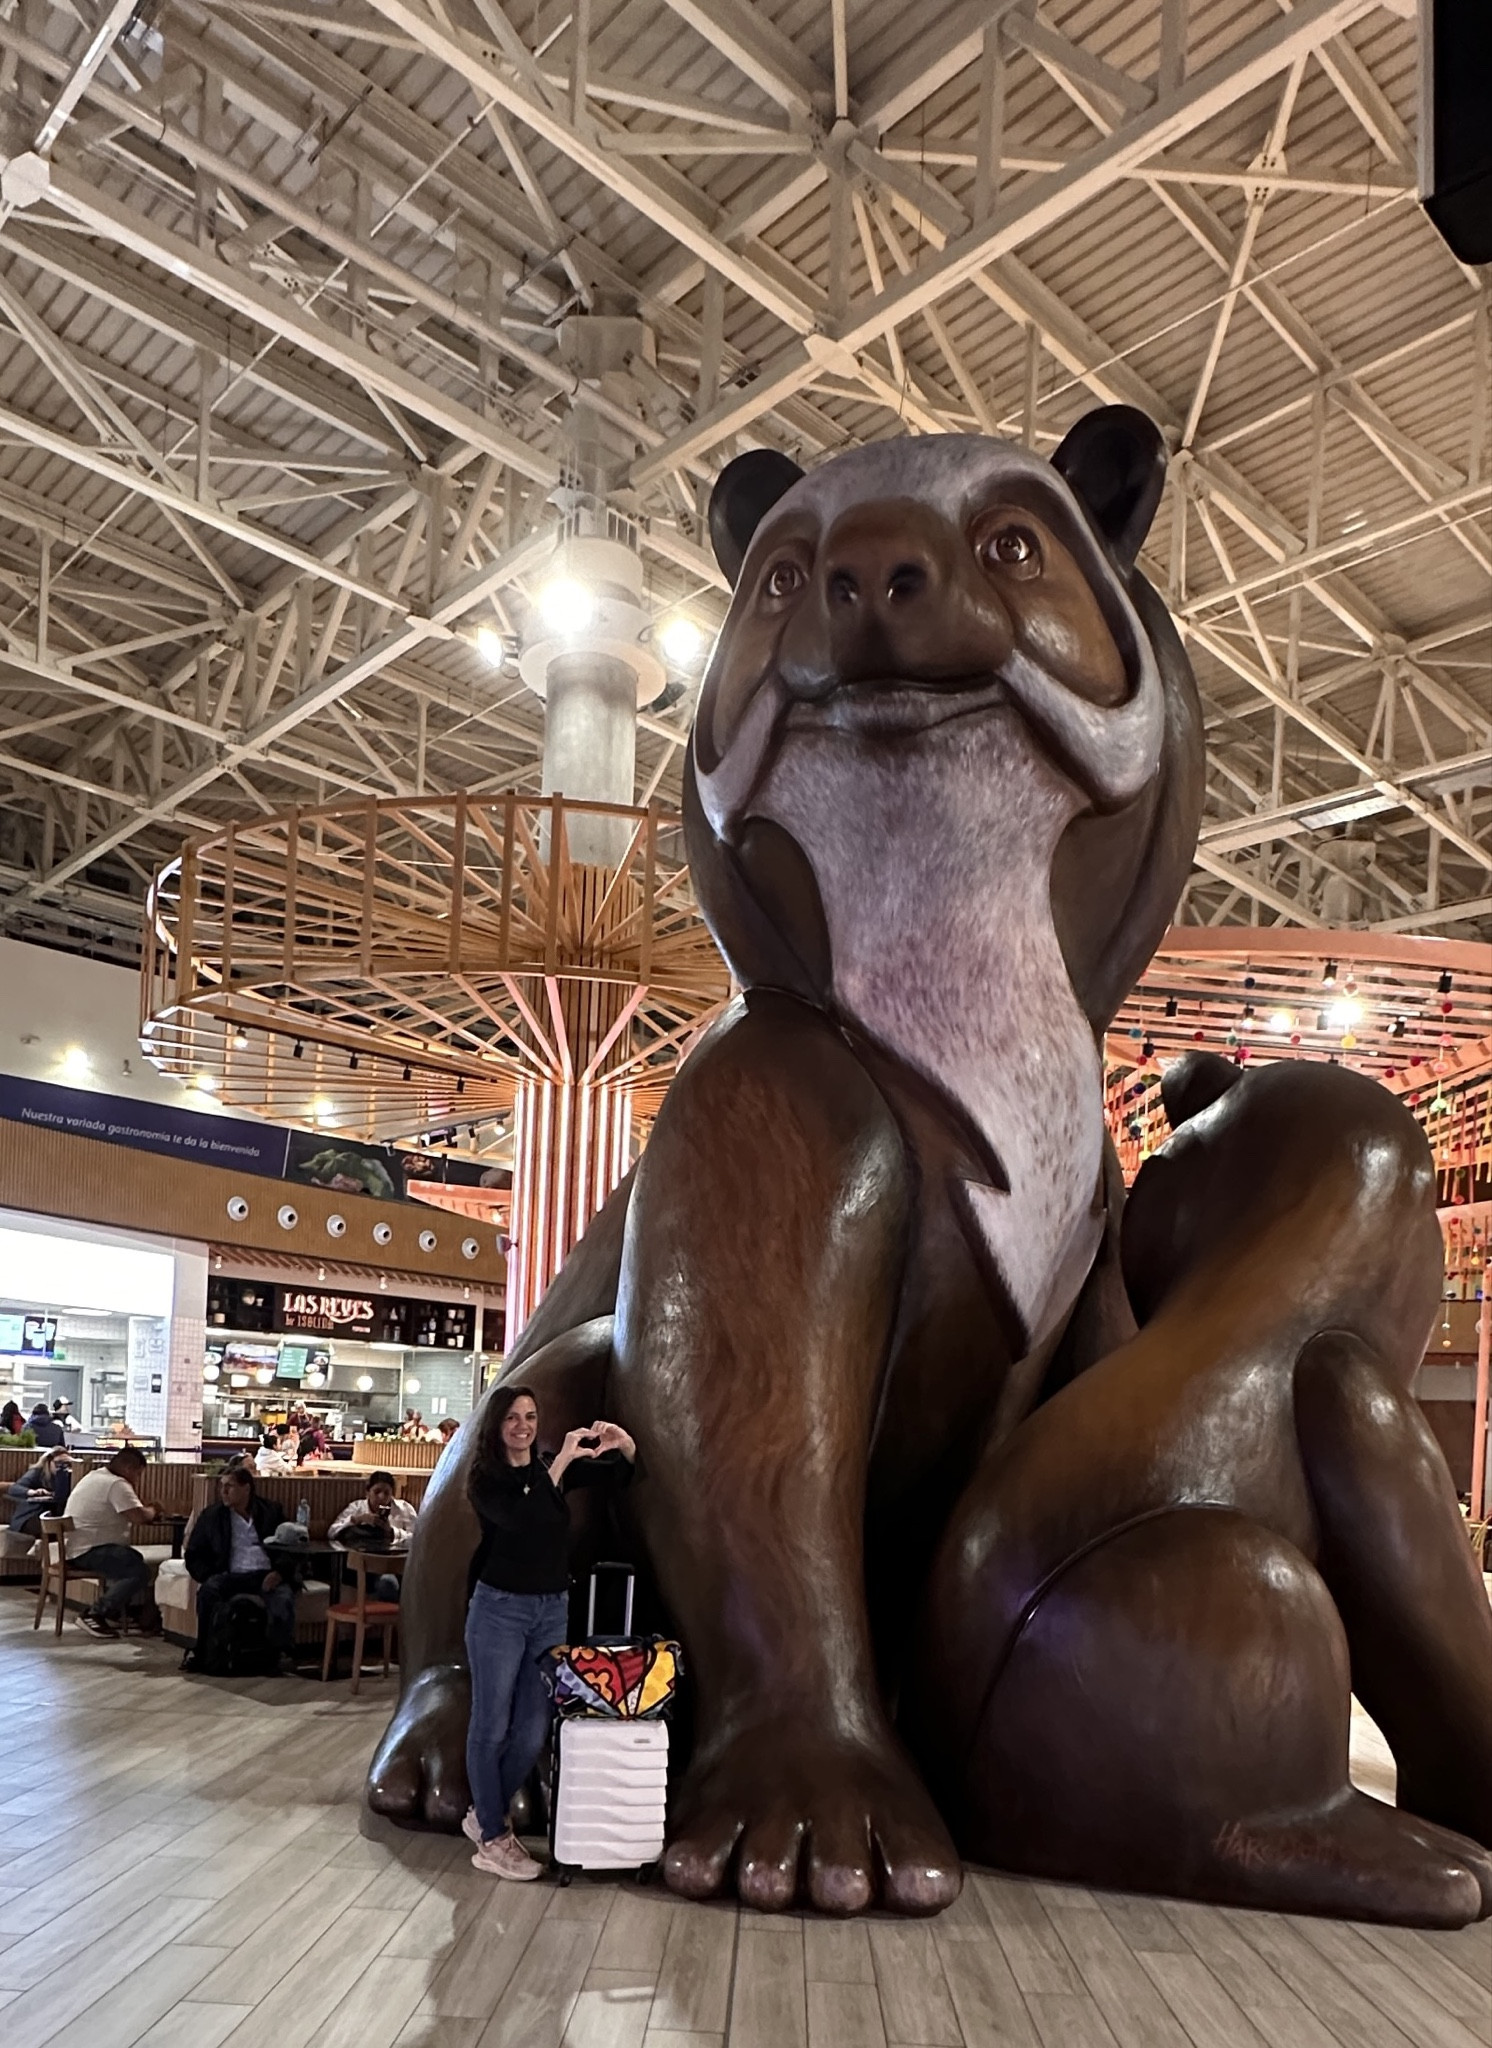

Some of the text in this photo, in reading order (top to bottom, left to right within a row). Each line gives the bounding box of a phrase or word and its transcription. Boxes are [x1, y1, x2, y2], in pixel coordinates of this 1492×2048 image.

[21, 1107, 64, 1124] Nuestra
[66, 1117, 106, 1131] variada
[173, 1134, 182, 1145] te
[184, 1135, 197, 1147] da
[199, 1137, 209, 1149] la
[210, 1140, 260, 1157] bienvenida
[283, 1293, 374, 1323] LAS REYES
